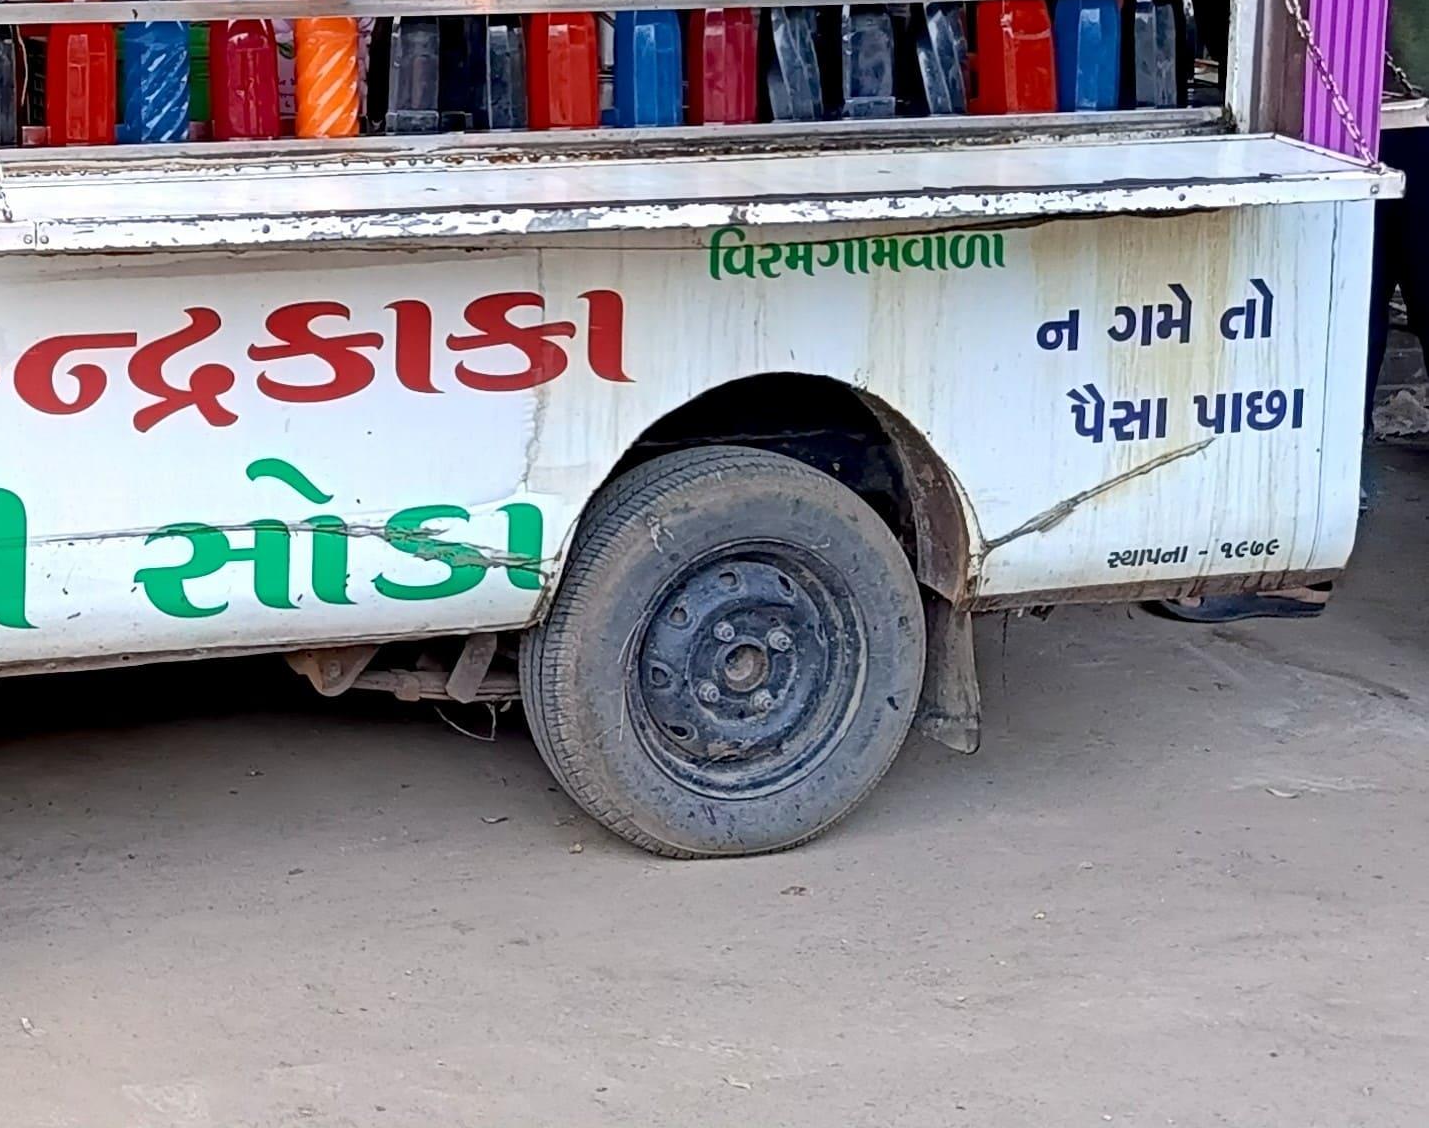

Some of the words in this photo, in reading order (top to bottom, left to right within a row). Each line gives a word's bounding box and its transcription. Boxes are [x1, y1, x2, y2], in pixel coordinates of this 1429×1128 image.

[709, 225, 1006, 280] વિરમગામવાળા
[1036, 308, 1081, 352] ન
[1107, 283, 1193, 347] ગમે
[1219, 278, 1274, 341] તો
[1066, 386, 1168, 444] પૈસા
[1193, 388, 1305, 437] પાછા
[133, 457, 560, 620] સોડા
[1107, 544, 1187, 570] સ્થાપના
